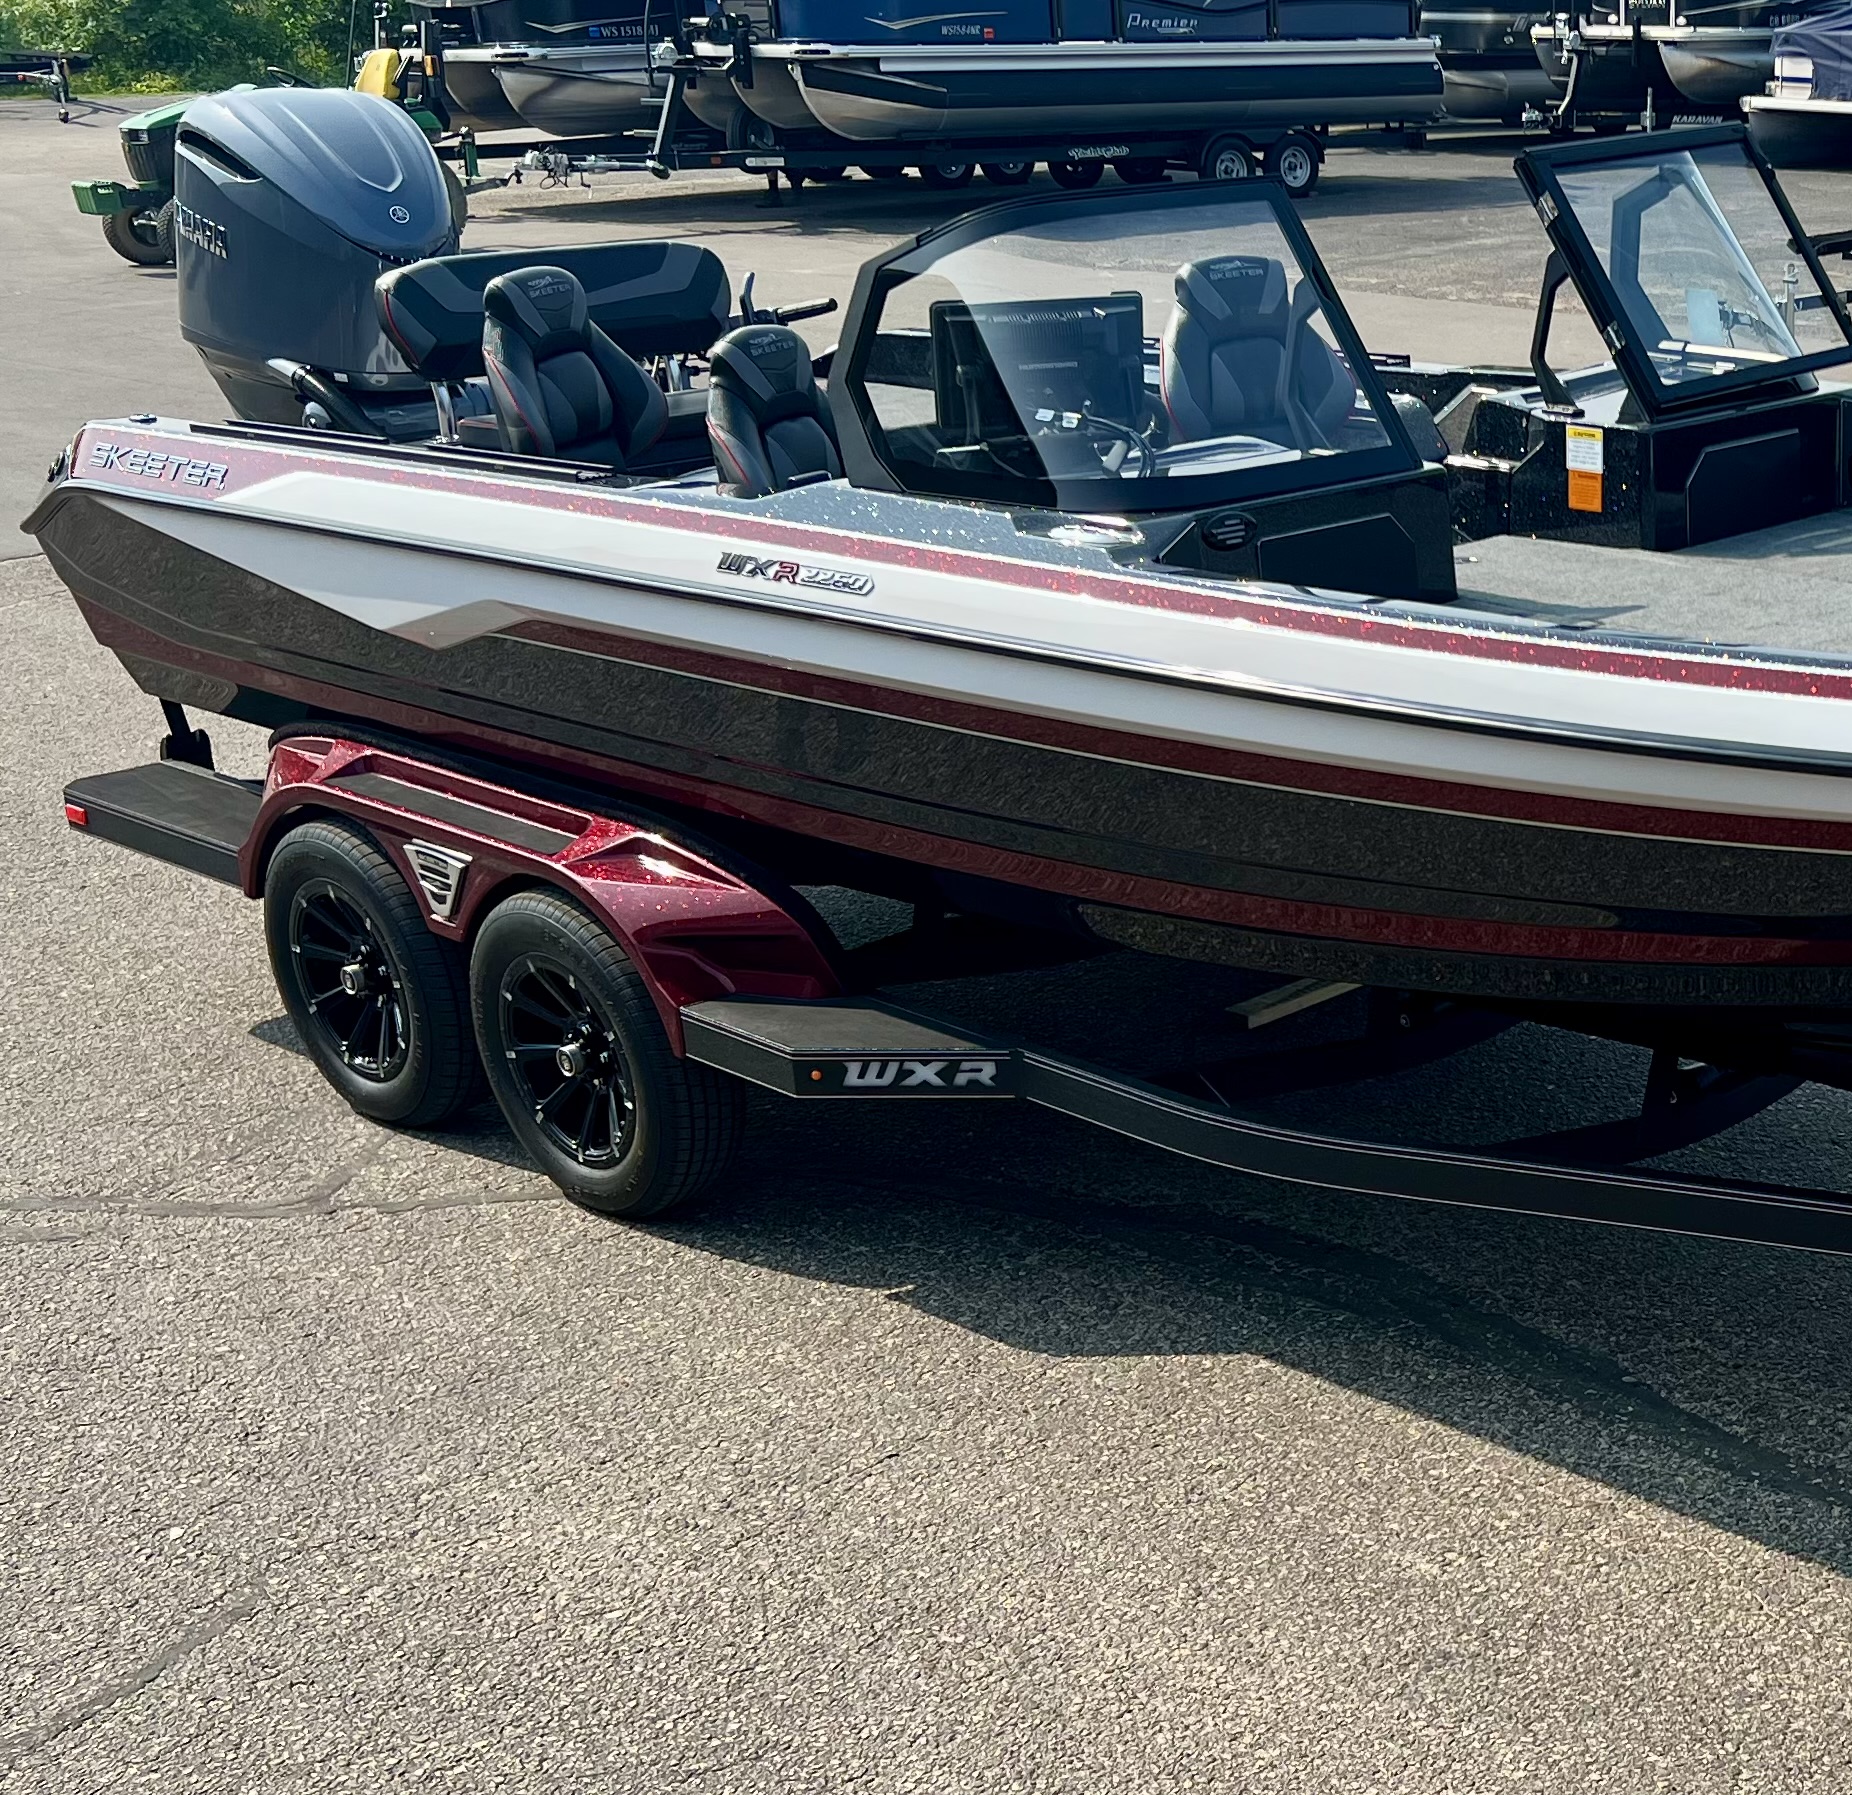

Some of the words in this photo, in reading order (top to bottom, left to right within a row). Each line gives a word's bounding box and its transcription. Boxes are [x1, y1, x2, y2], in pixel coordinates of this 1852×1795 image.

[601, 26, 619, 37] WS
[1672, 114, 1724, 124] KARAVAN
[173, 196, 228, 260] AMAHA
[1209, 268, 1264, 281] SKEETER
[529, 283, 572, 298] SKEETER
[750, 340, 796, 357] SKEETER
[89, 441, 229, 490] SKEETER
[716, 551, 800, 584] WXR
[842, 1061, 998, 1087] WXR
